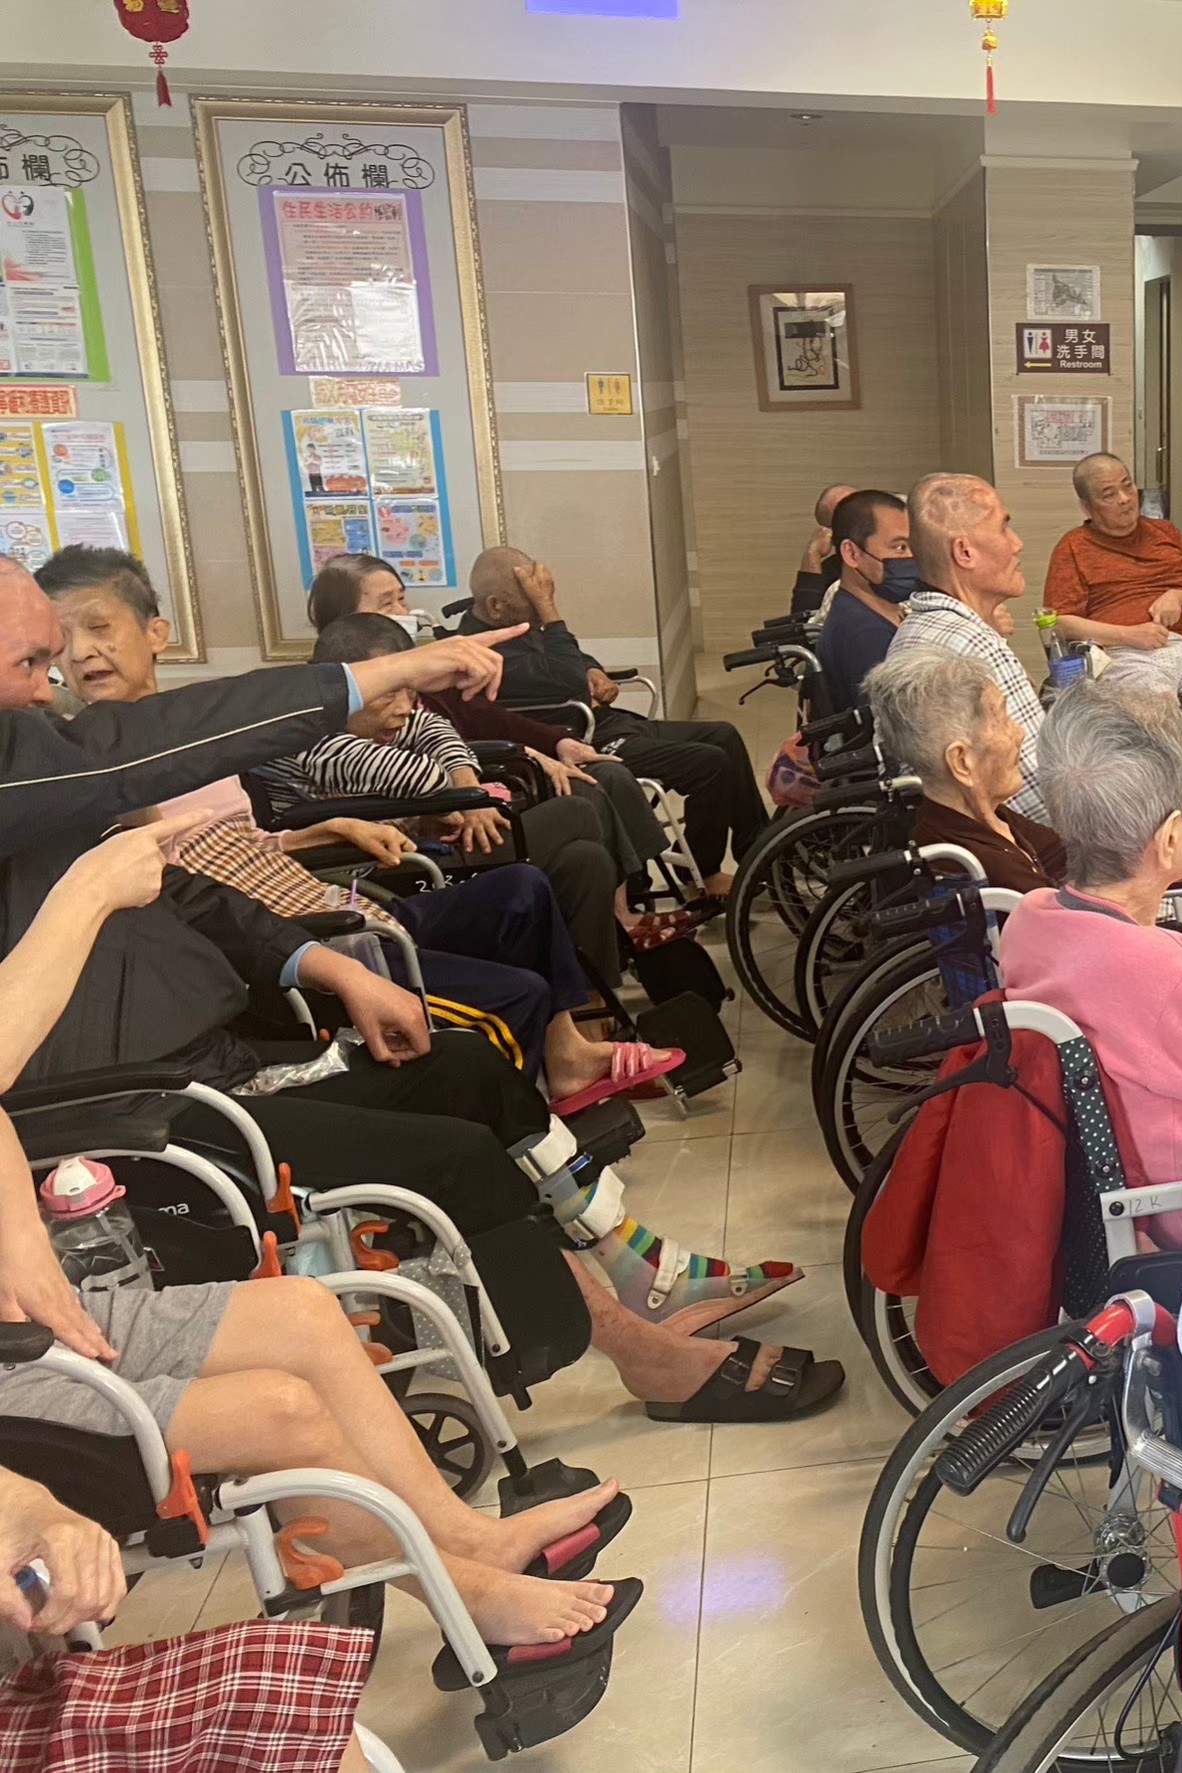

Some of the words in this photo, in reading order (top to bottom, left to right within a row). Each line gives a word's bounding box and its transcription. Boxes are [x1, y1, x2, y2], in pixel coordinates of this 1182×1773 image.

[286, 163, 389, 188] 公佈欄
[282, 201, 373, 219] 住民生活公約
[1065, 329, 1096, 343] 男女
[1056, 345, 1105, 359] 洗手間
[1060, 360, 1102, 368] Restroom
